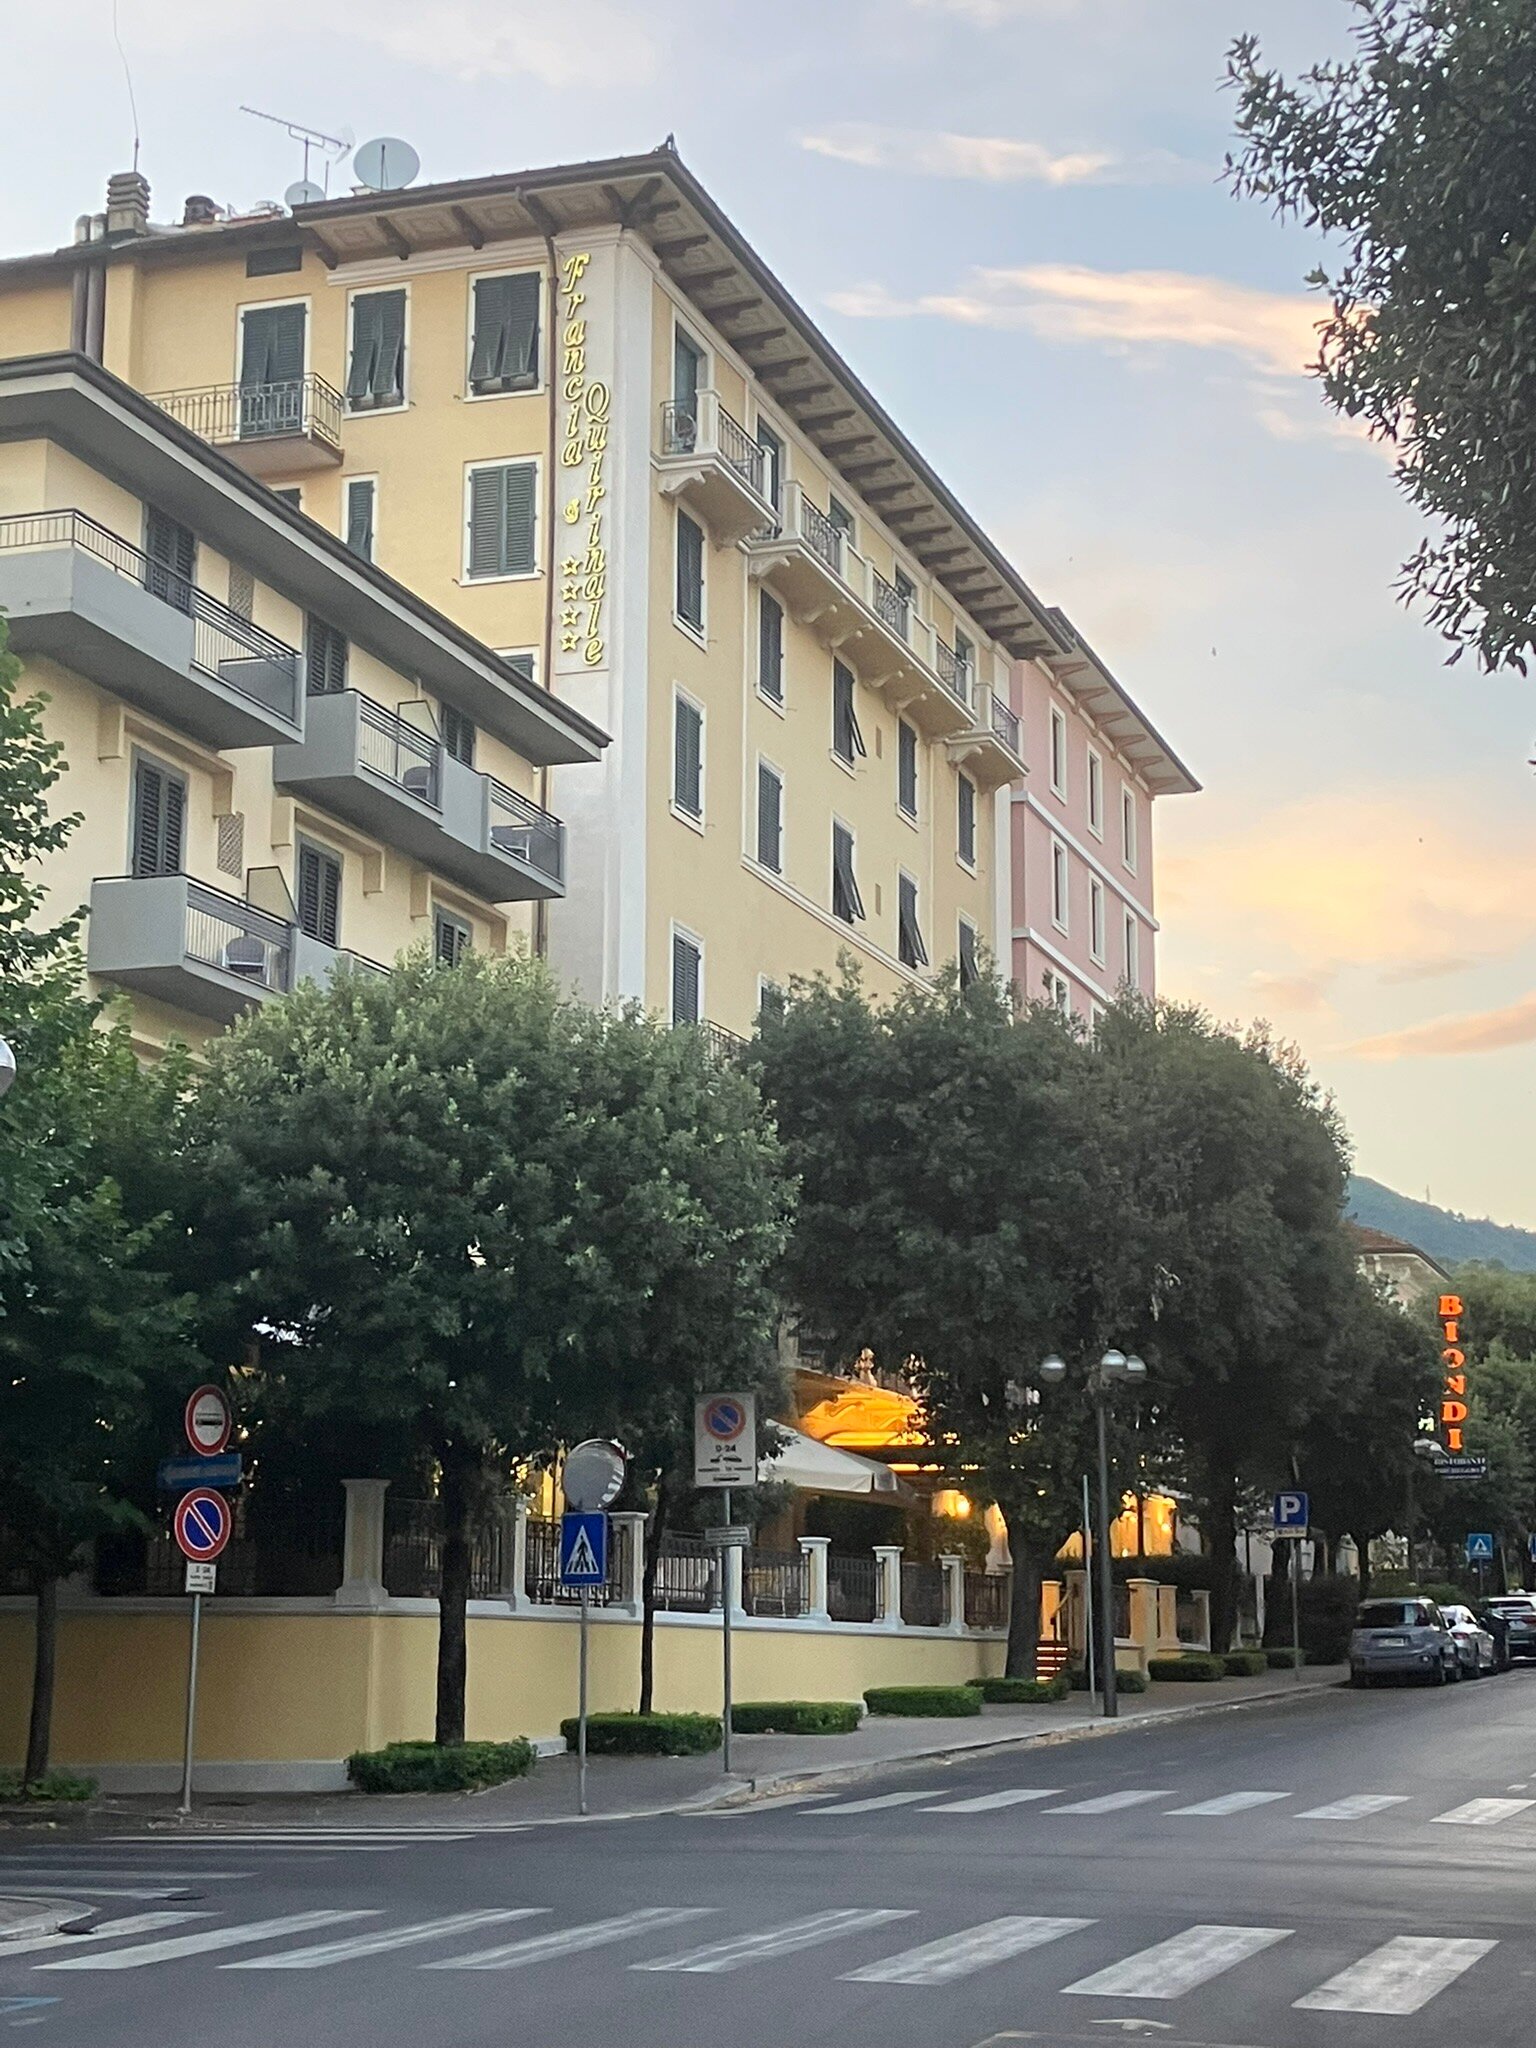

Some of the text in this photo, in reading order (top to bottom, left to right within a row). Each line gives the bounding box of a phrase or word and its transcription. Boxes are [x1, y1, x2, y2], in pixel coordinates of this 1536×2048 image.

[561, 253, 590, 467] Francia
[583, 381, 610, 666] Quirinale
[1438, 1294, 1468, 1451] BIONDI
[1279, 1495, 1301, 1523] P
